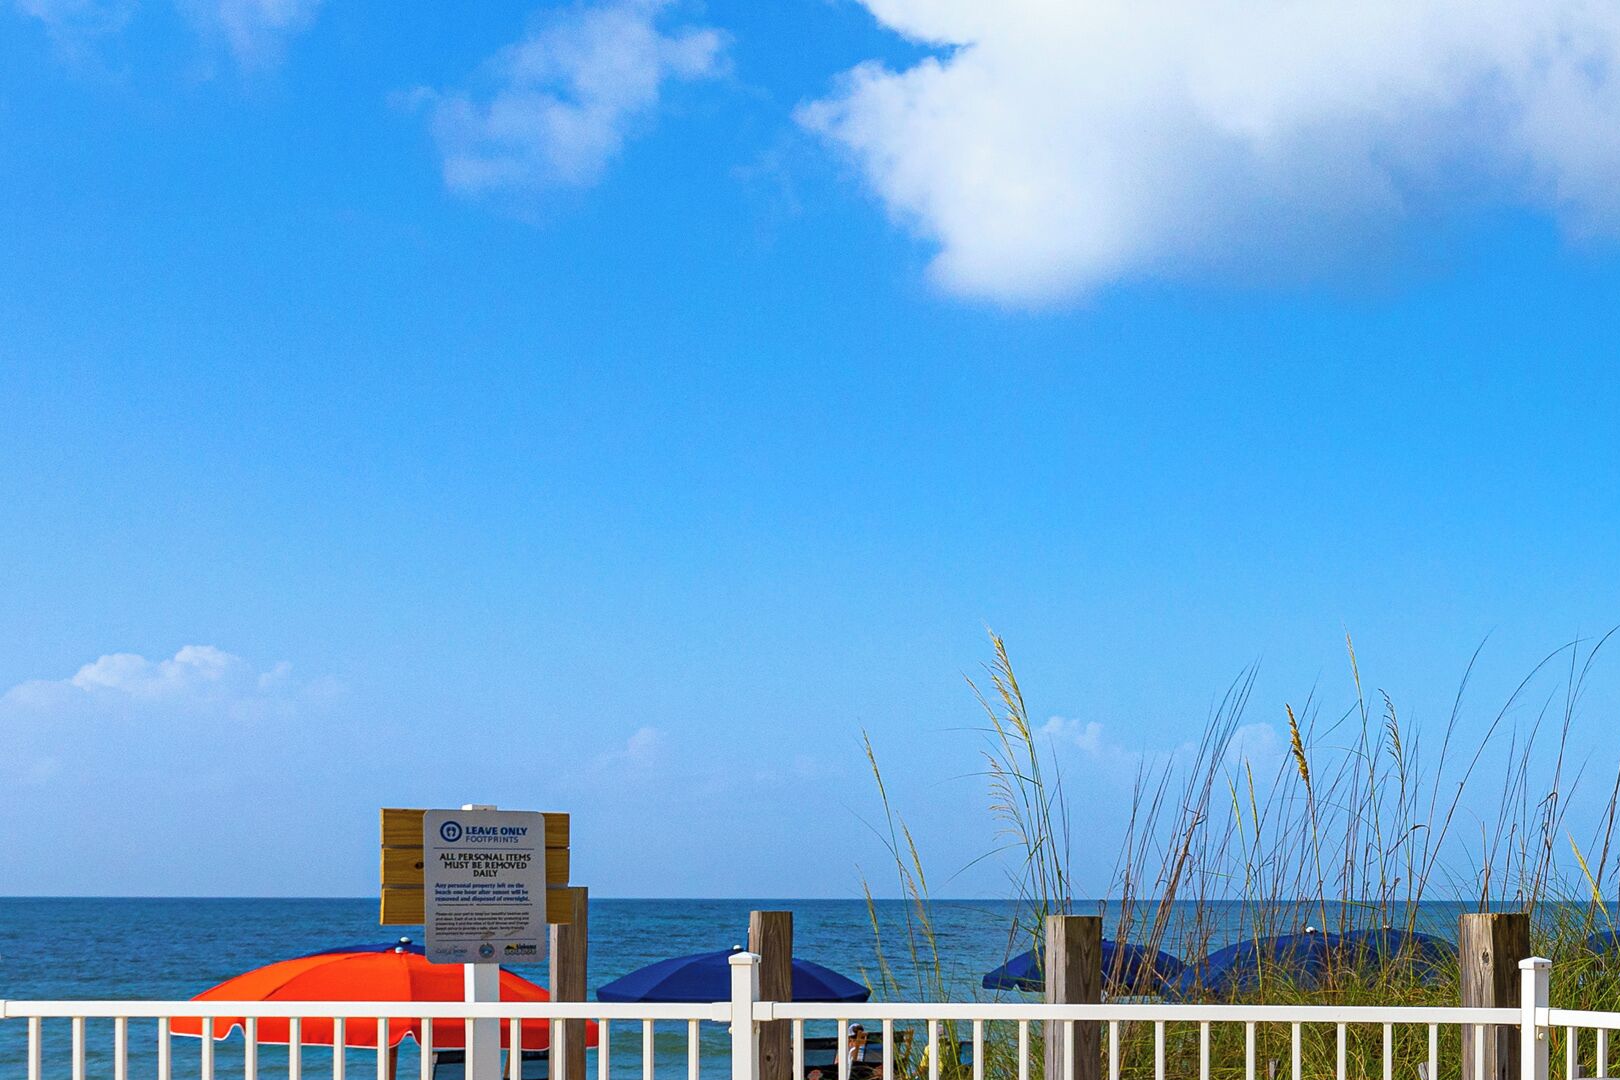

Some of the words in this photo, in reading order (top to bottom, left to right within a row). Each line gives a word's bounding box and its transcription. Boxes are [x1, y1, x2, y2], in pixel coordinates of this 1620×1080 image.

[465, 826, 498, 835] LEAVE
[500, 827, 528, 836] ONLY
[439, 853, 456, 861] ALL
[458, 853, 504, 861] PERSONAL
